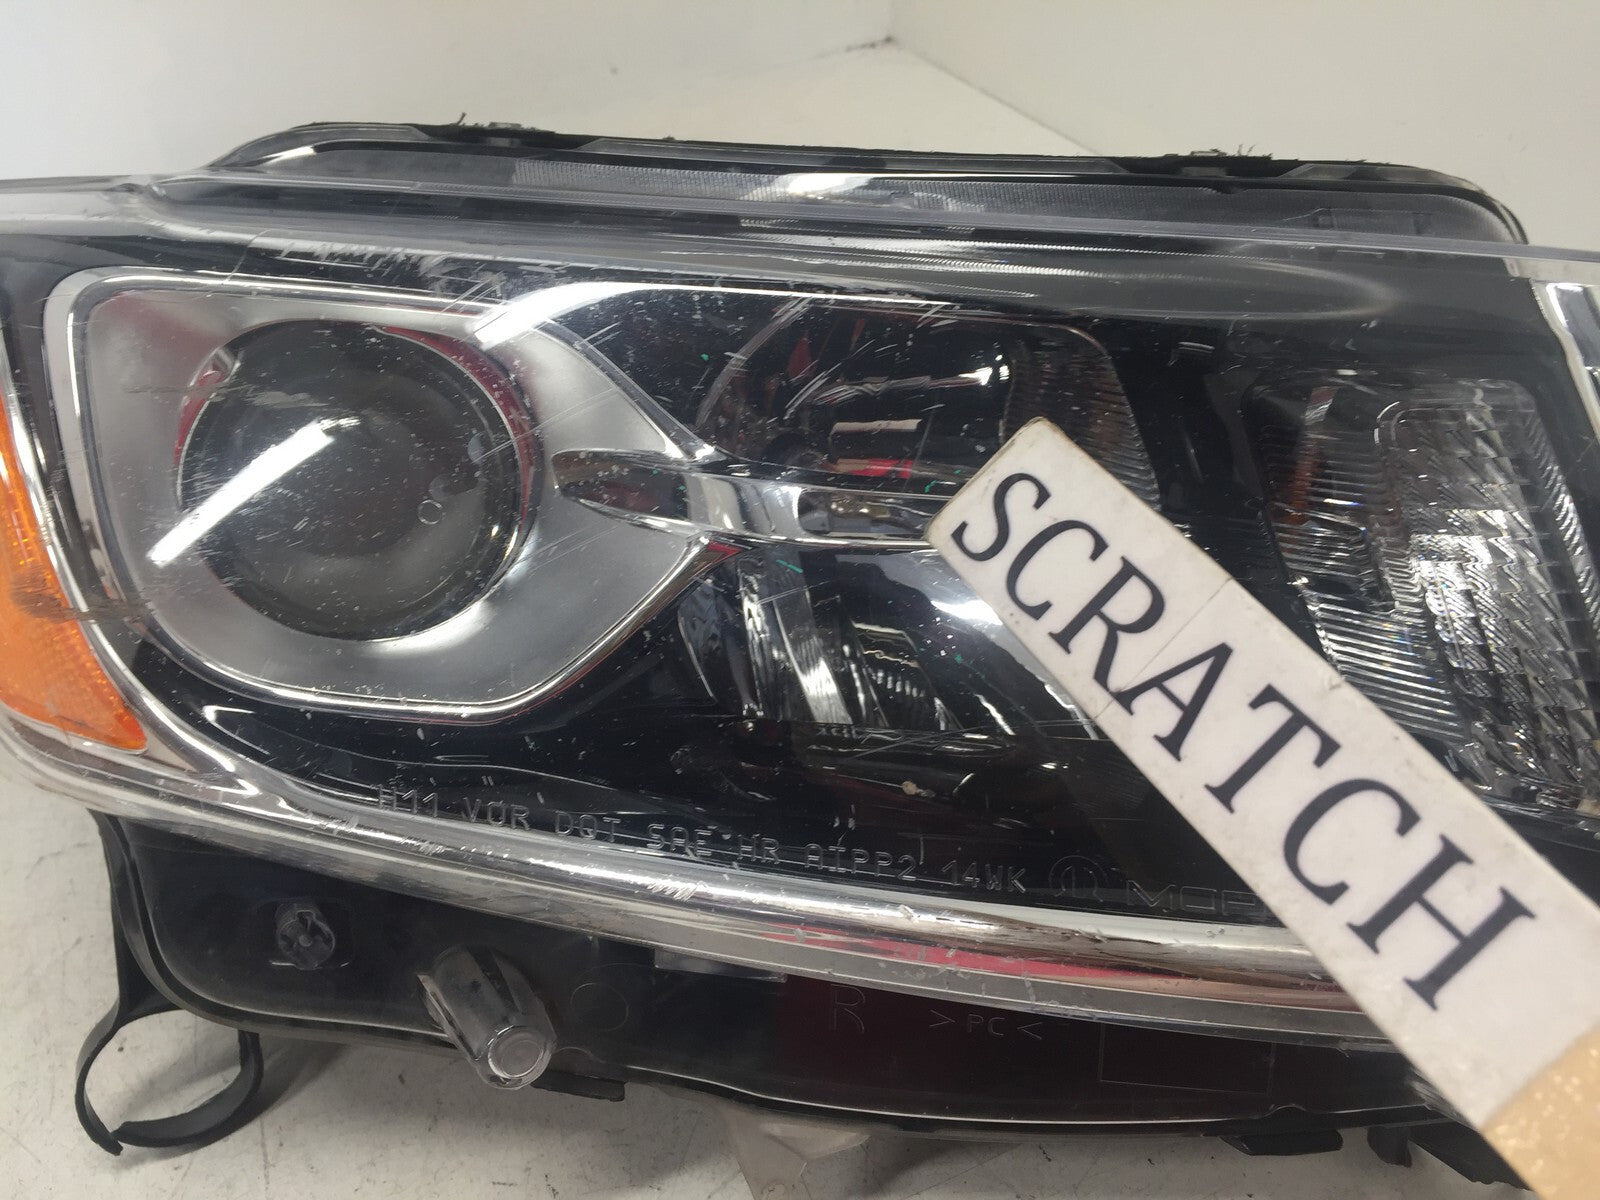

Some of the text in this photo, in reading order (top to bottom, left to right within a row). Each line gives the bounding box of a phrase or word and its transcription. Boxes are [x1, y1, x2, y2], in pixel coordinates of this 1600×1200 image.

[950, 472, 1537, 1011] SCRATCH
[377, 783, 438, 818] H11
[646, 822, 712, 857] SAE
[737, 833, 780, 865] HR
[942, 860, 1027, 894] 14WK
[1126, 878, 1270, 917] MOP
[829, 982, 866, 1034] R
